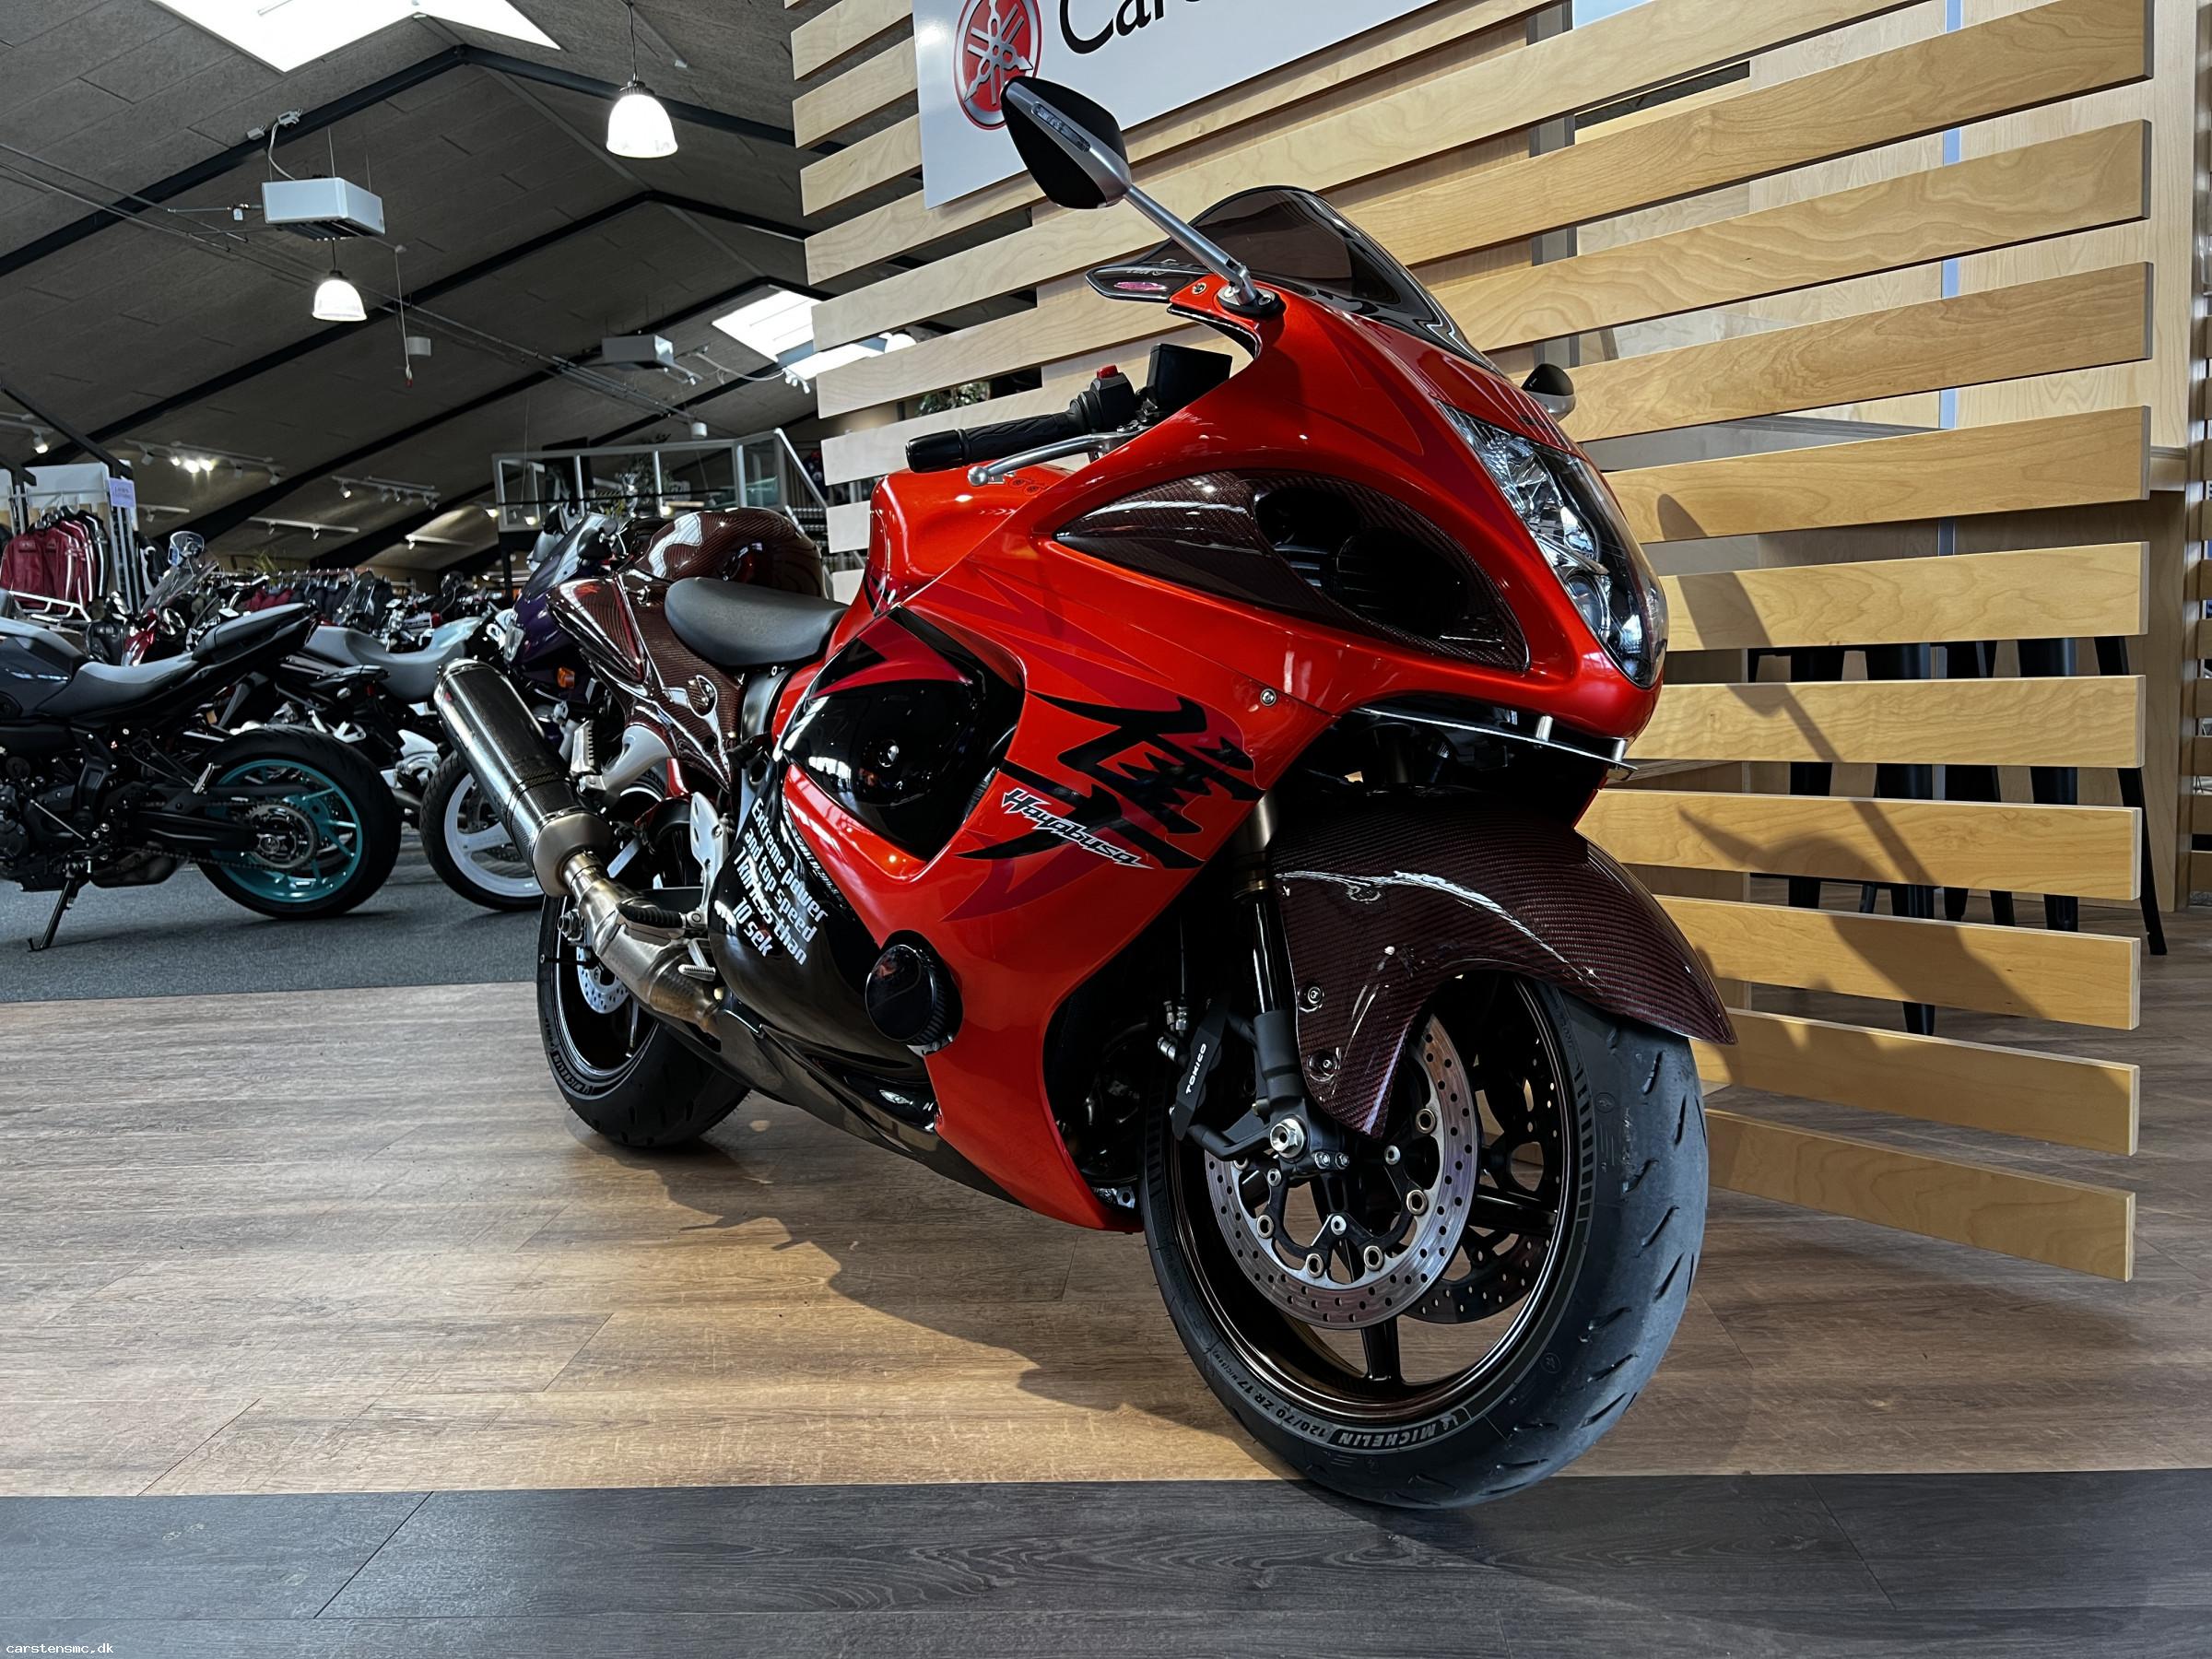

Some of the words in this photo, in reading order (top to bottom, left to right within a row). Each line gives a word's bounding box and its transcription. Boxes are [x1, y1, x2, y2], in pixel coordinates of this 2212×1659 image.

[1001, 787, 1154, 869] Hayabusa
[750, 797, 786, 873] Extreme
[781, 870, 829, 922] power
[744, 828, 763, 864] and
[759, 857, 777, 892] top
[774, 888, 818, 943] speed
[733, 897, 753, 924] 10
[744, 922, 773, 957] sek
[773, 920, 807, 966] than
[1185, 1043, 1207, 1094] TOKICO
[1254, 1393, 1277, 1409] ZR
[1277, 1408, 1327, 1436] 120/70
[1338, 1426, 1437, 1447] MICHELIN
